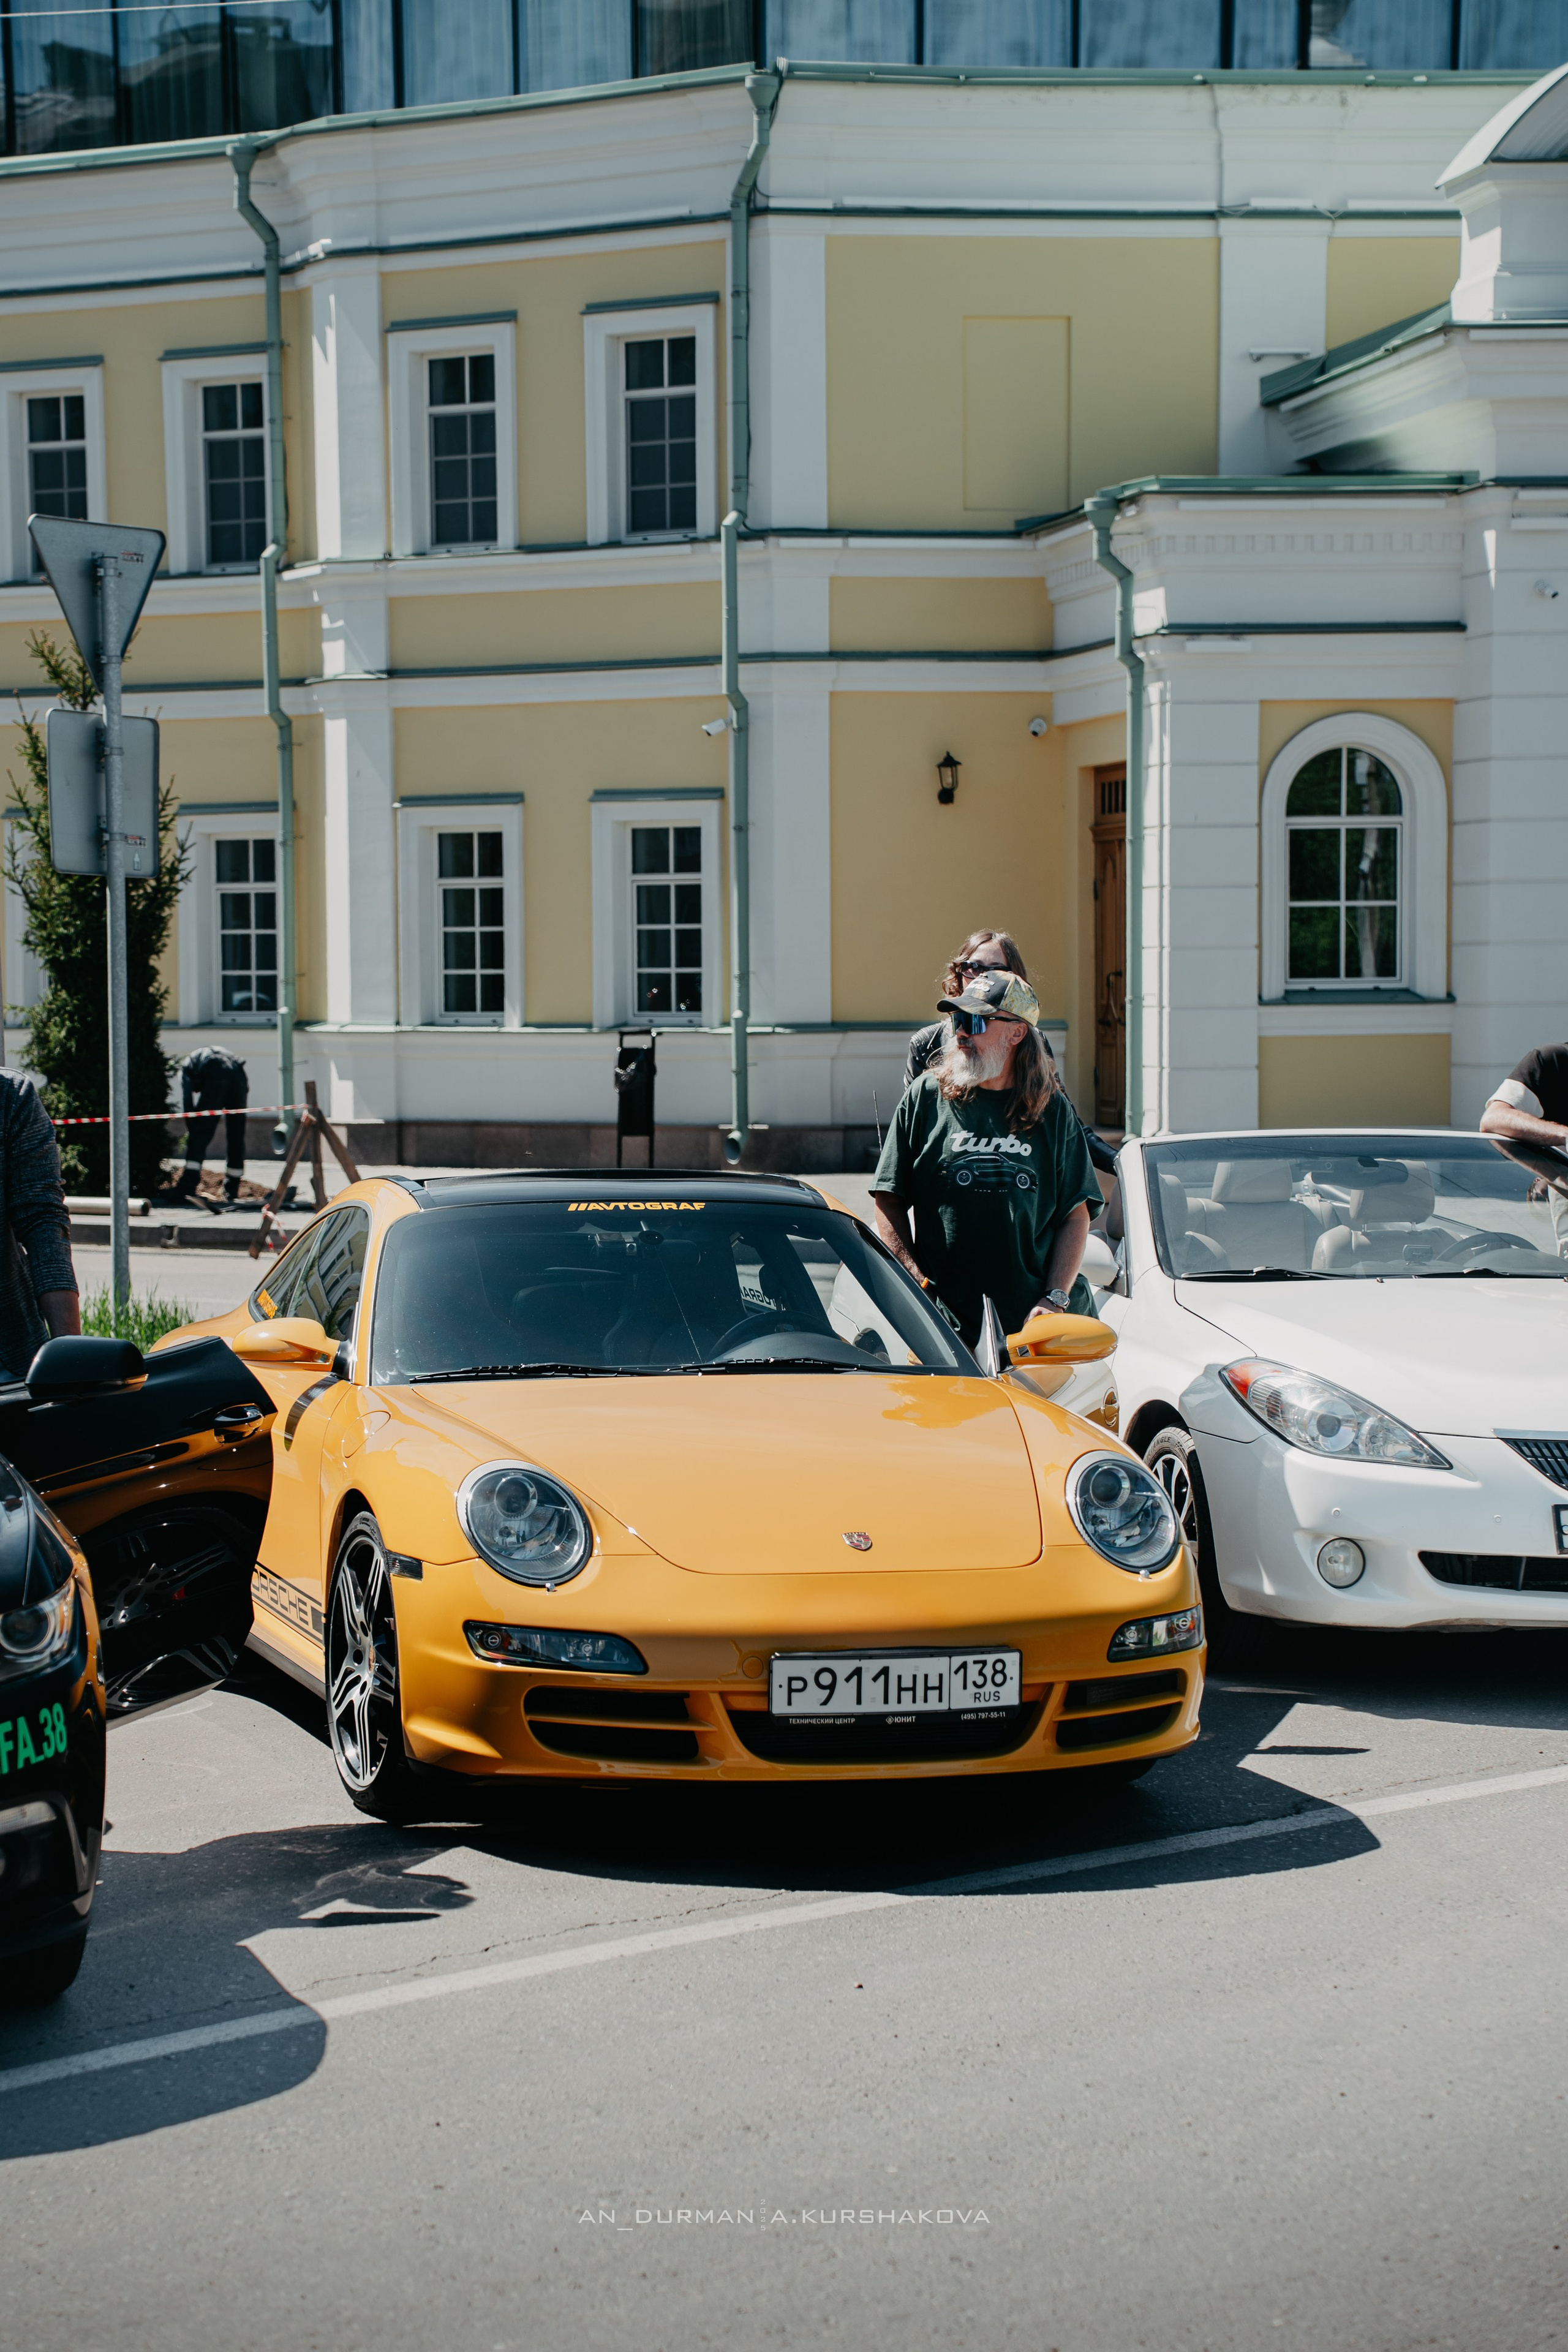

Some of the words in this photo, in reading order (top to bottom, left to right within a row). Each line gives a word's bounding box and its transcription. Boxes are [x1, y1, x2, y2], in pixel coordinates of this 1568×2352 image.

[950, 1130, 1032, 1156] turbo
[251, 1567, 309, 1626] ORSCHE
[953, 1659, 1008, 1691] 138
[974, 1691, 1000, 1703] RUS
[961, 1712, 976, 1721] (495)
[0, 1702, 67, 1774] FA_38
